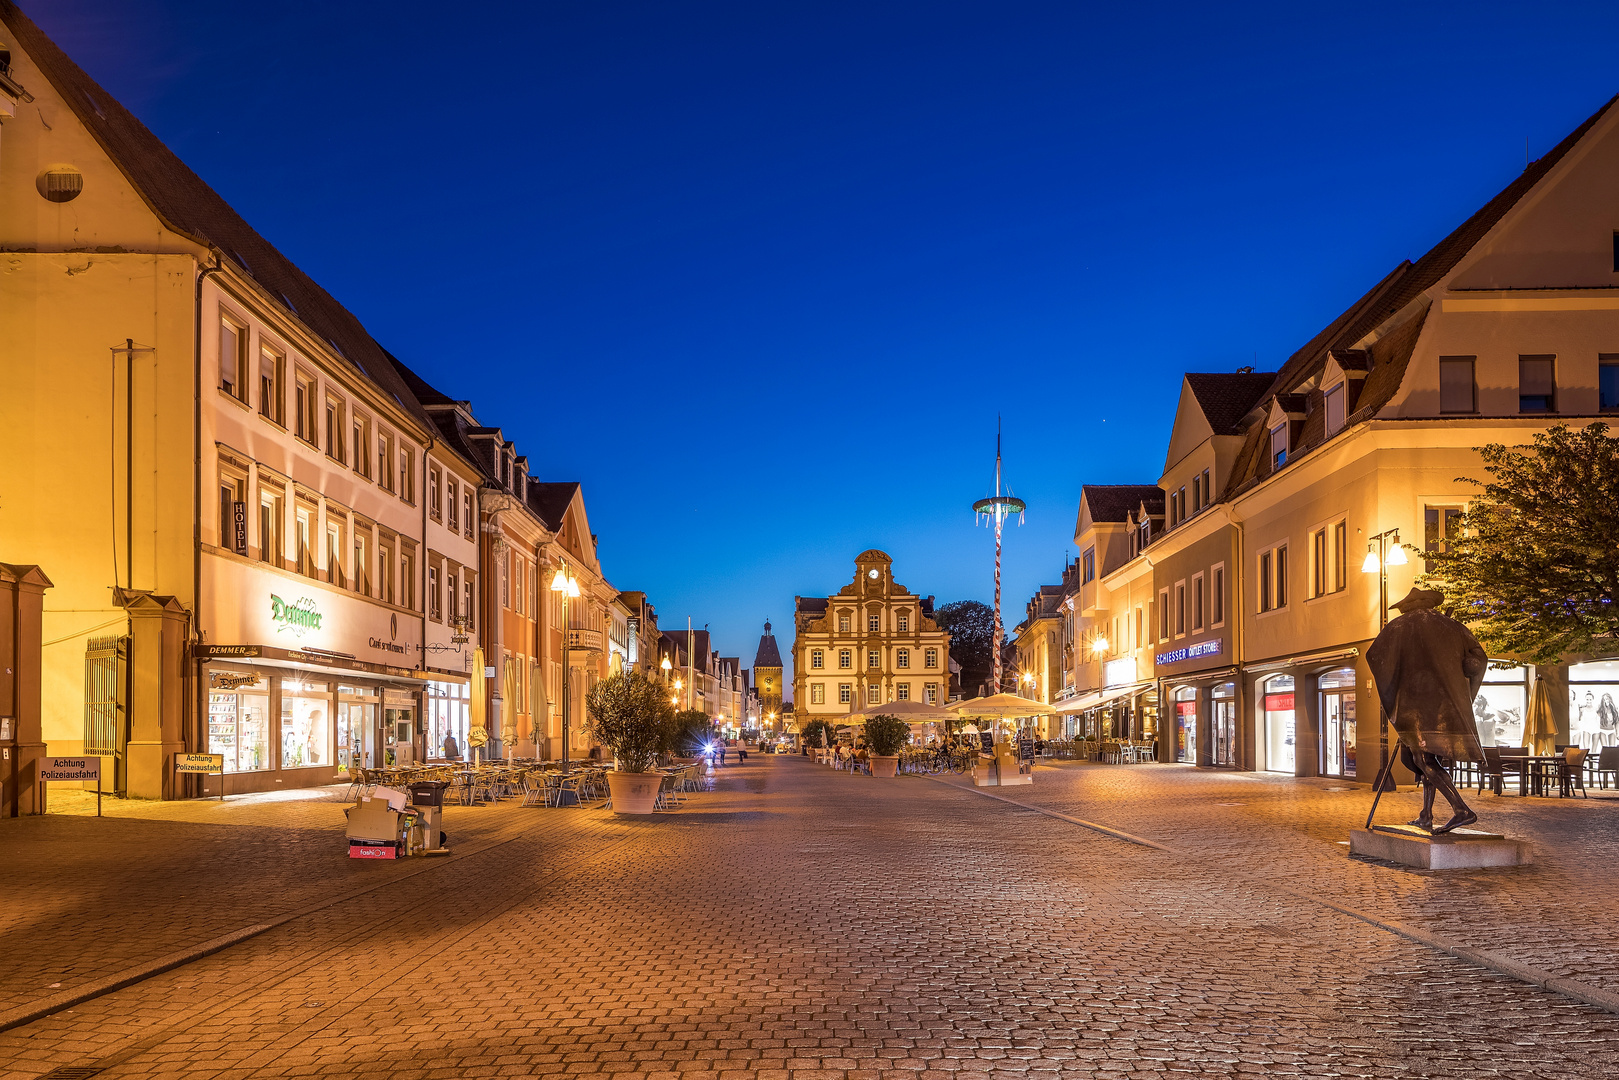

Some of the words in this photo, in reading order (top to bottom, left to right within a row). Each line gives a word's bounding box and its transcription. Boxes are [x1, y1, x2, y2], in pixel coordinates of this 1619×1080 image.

[235, 504, 245, 548] HOTEL
[270, 593, 322, 632] Demmer
[209, 646, 246, 654] DEMMER
[1156, 648, 1187, 665] SCHIESSER
[1188, 644, 1203, 658] OUTLET
[1203, 641, 1218, 654] STORE
[219, 675, 256, 687] Demmer
[1278, 697, 1294, 708] SALE
[185, 754, 213, 763] Achtung
[53, 759, 85, 769] Achtung
[176, 763, 222, 772] Polizeiausfahrt
[41, 770, 98, 779] Polizeiausfahrt
